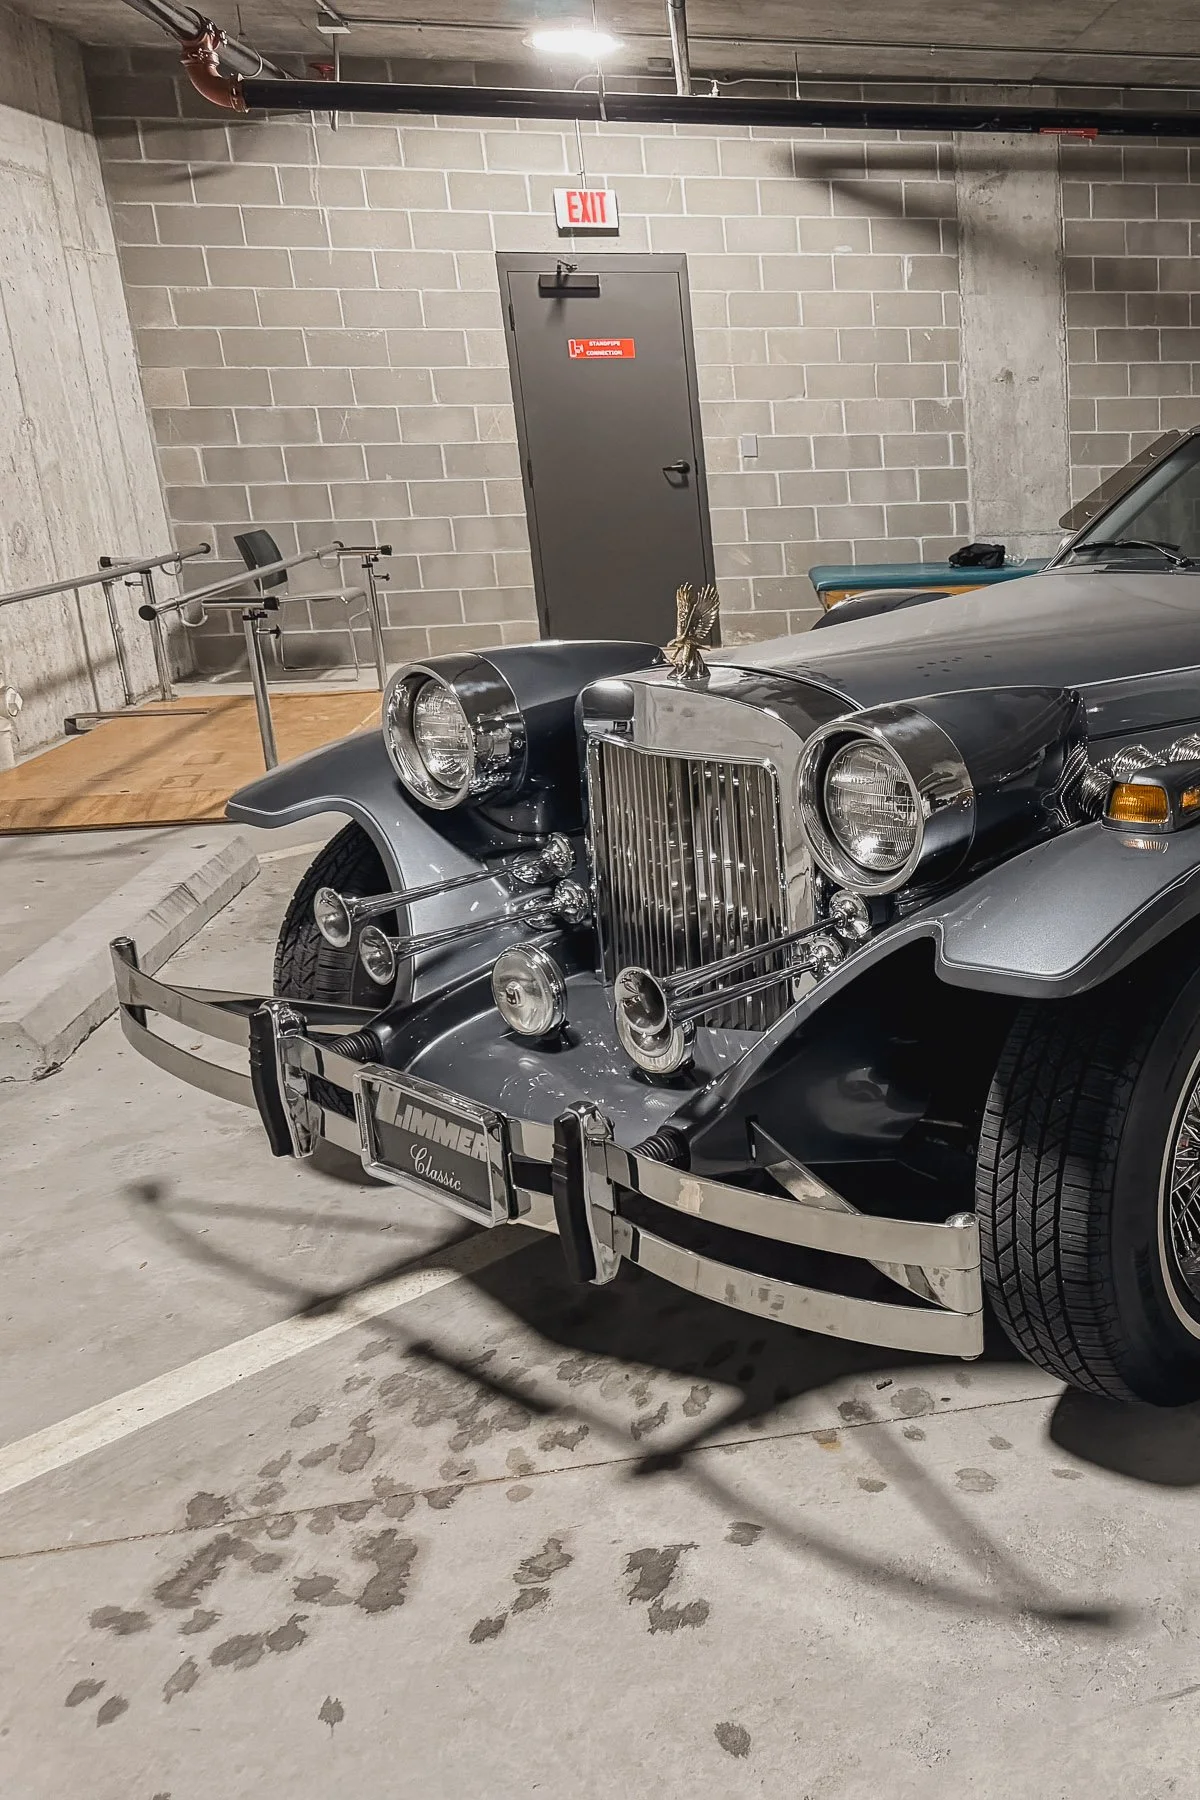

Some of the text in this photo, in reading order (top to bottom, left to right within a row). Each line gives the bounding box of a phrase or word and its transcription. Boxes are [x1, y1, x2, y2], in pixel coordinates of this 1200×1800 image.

[566, 191, 606, 224] EXIT
[371, 1080, 488, 1163] ZIMMER
[410, 1143, 462, 1191] Classic
